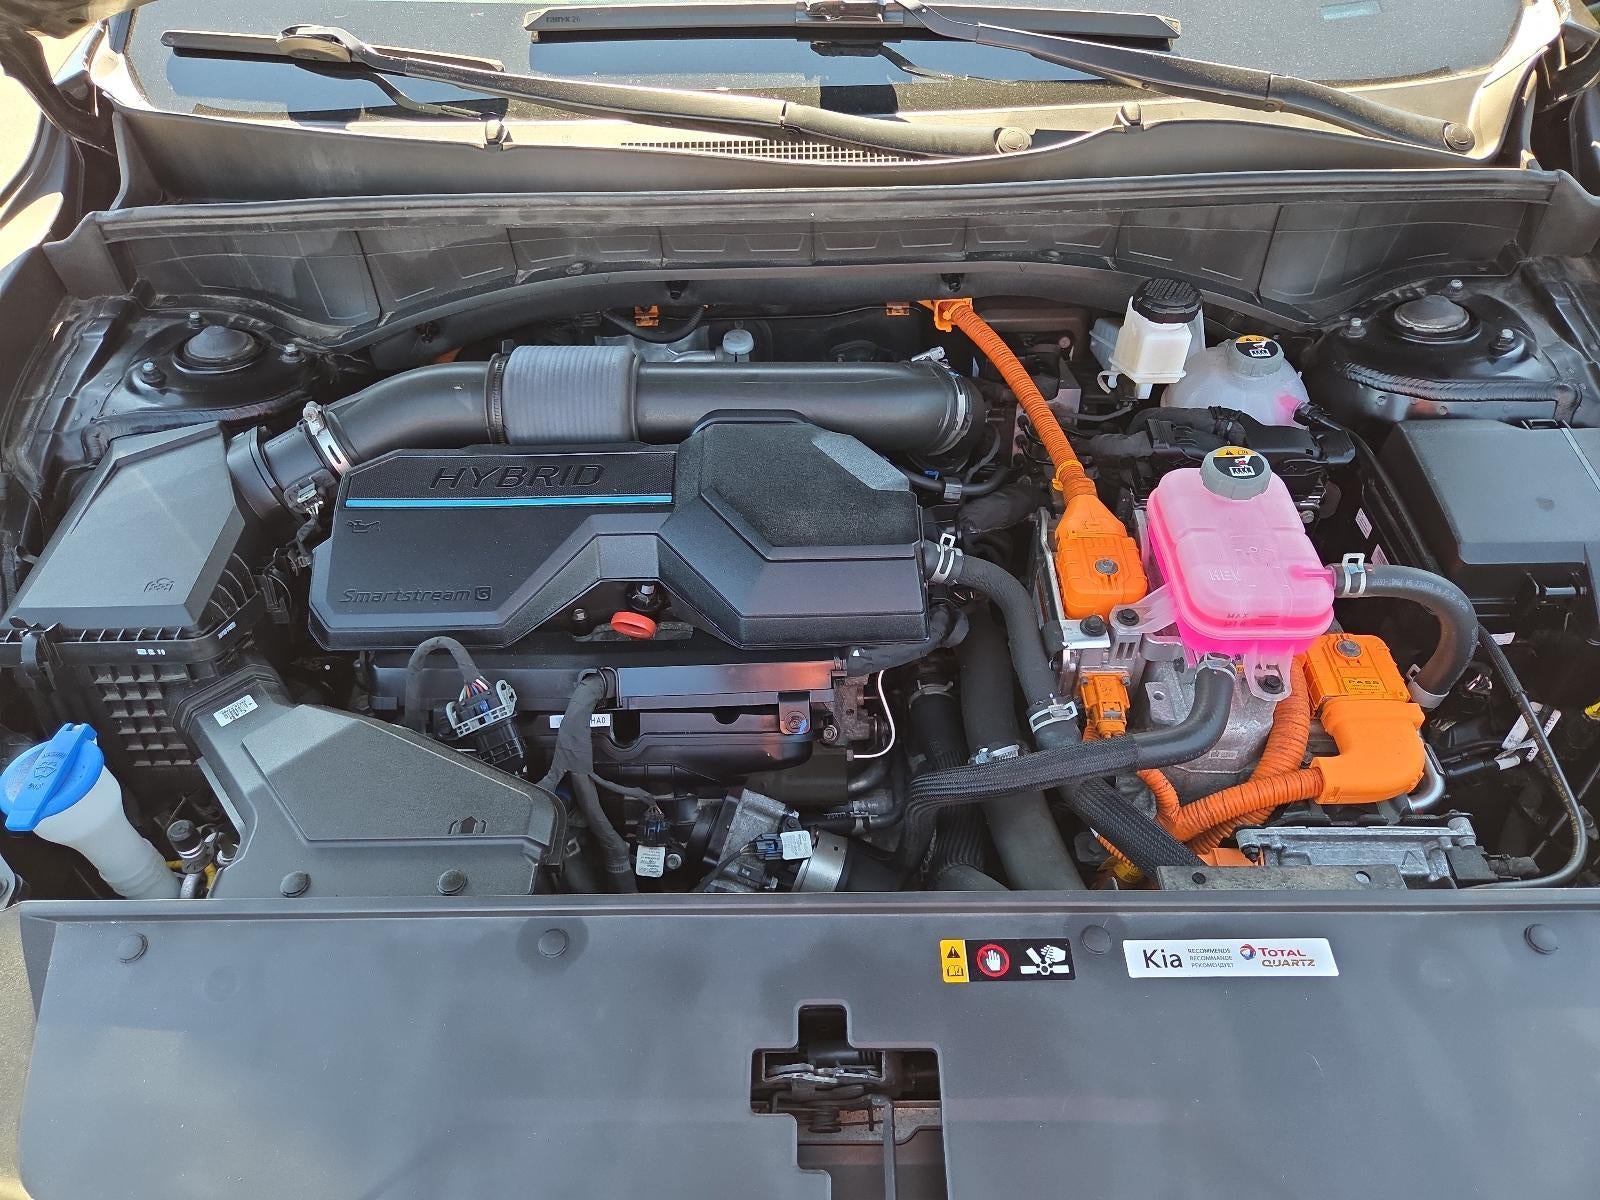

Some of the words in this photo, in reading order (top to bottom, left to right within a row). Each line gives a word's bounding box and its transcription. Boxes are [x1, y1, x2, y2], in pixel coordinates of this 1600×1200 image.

[429, 464, 606, 489] HYBRID
[340, 587, 472, 603] Smartstream
[1226, 611, 1248, 619] MAX
[1258, 947, 1306, 957] TOTAL
[1142, 949, 1184, 969] Kia
[1261, 959, 1316, 968] QUARTZ
